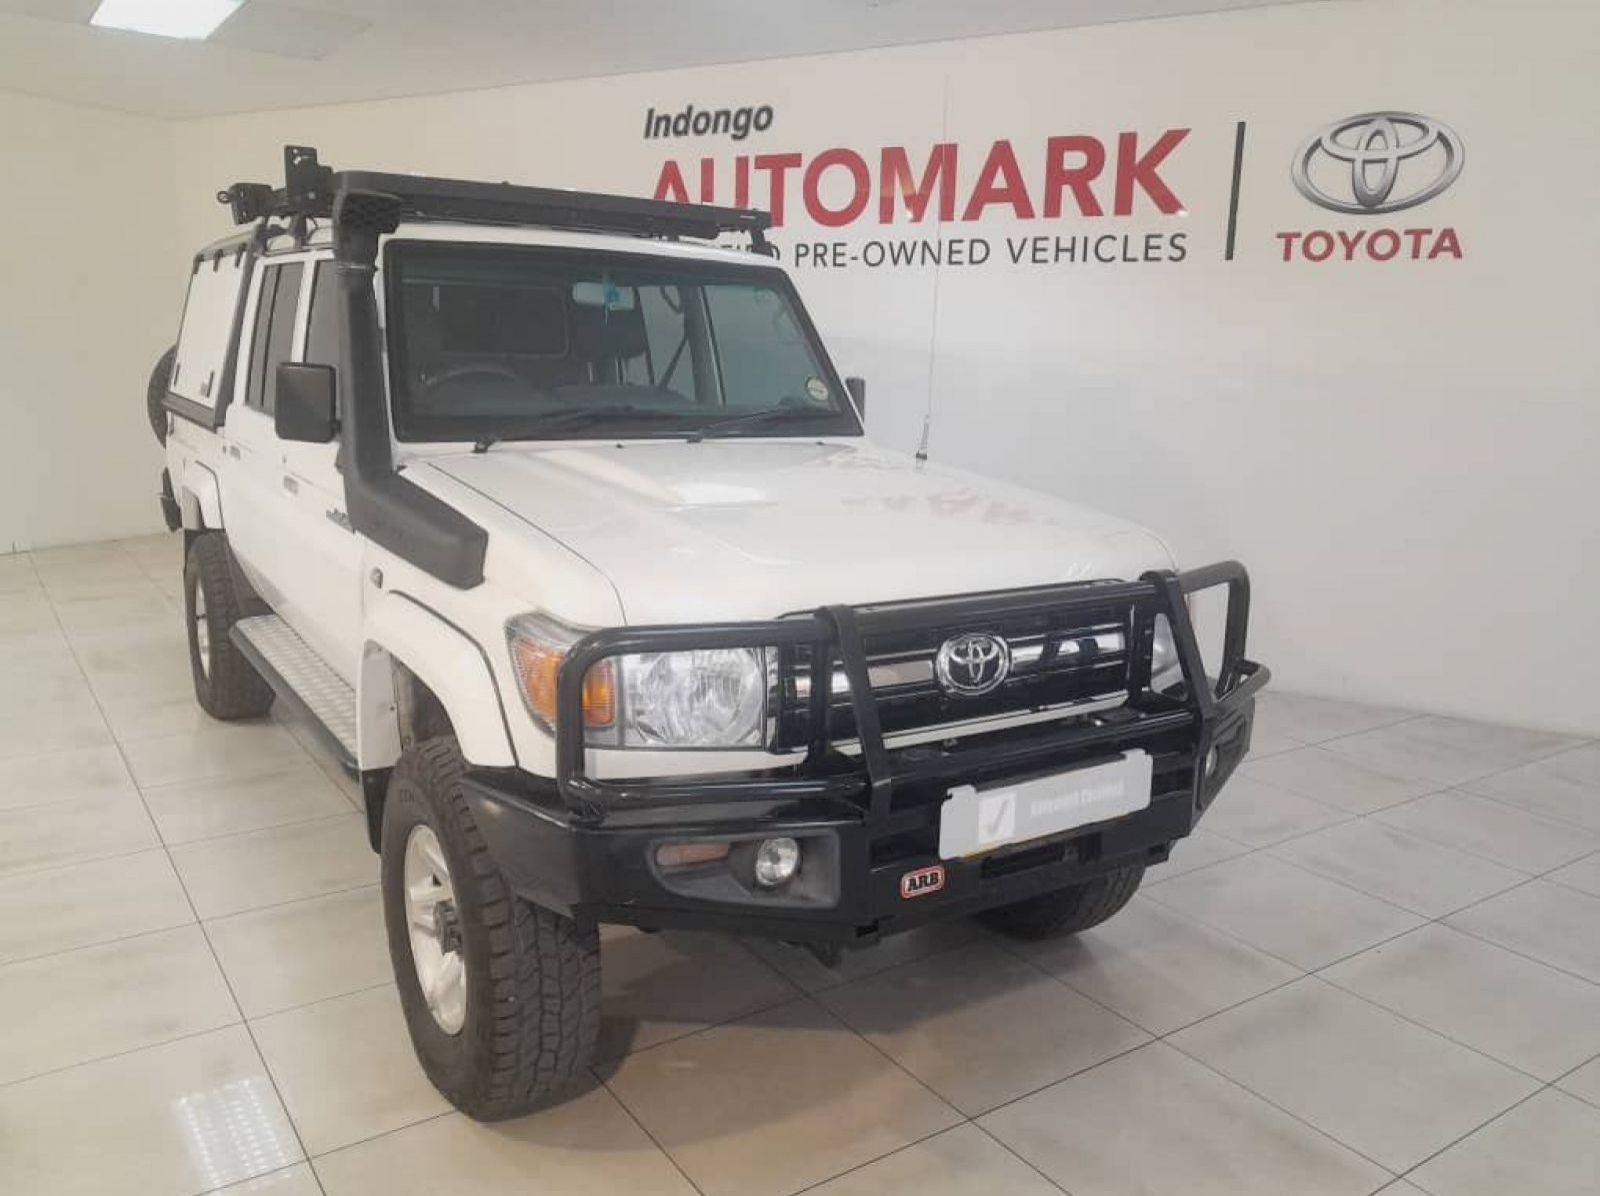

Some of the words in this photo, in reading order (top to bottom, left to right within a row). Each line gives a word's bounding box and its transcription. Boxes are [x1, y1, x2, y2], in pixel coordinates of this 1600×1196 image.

[644, 104, 774, 141] Indongo
[794, 238, 992, 268] PRE-OWNED
[1006, 232, 1188, 264] VEHICLES
[1276, 228, 1463, 262] TOYOTA
[907, 871, 940, 892] ARB
